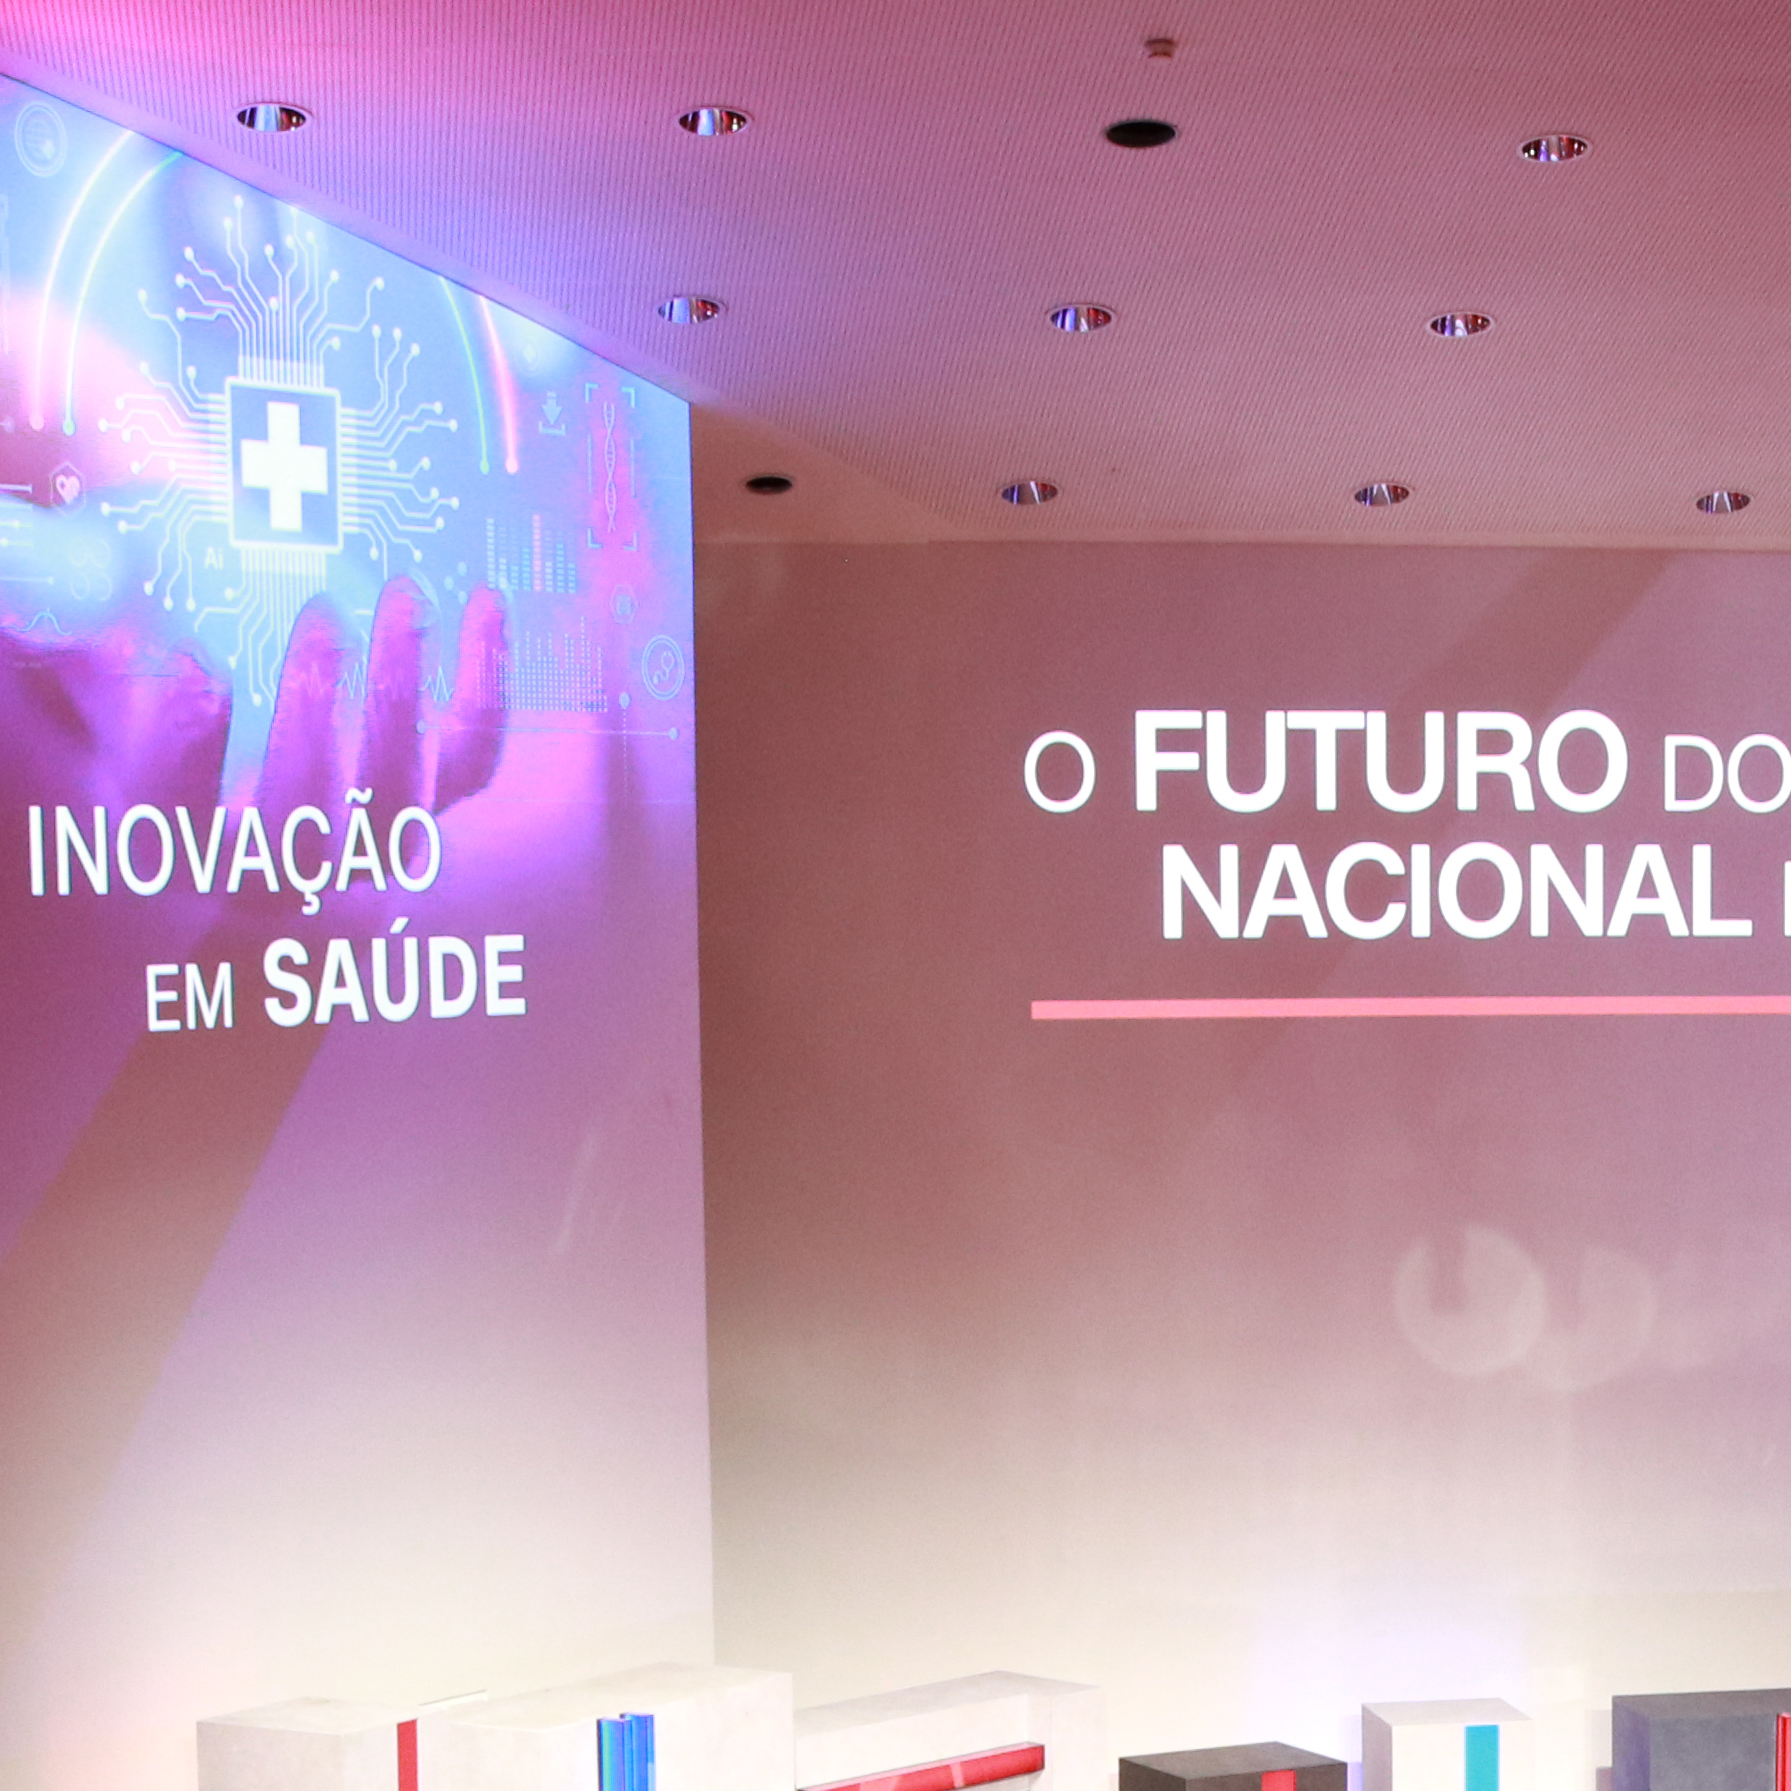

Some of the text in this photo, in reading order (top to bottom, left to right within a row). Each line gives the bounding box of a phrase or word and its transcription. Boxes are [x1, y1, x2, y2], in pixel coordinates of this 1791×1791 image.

[1023, 730, 1096, 813] O
[1134, 709, 1629, 813] FUTURO
[28, 787, 442, 916] INOVAÇÃO
[1162, 841, 1753, 939] NACIONAL
[146, 917, 527, 1032] EM SAÚDE
